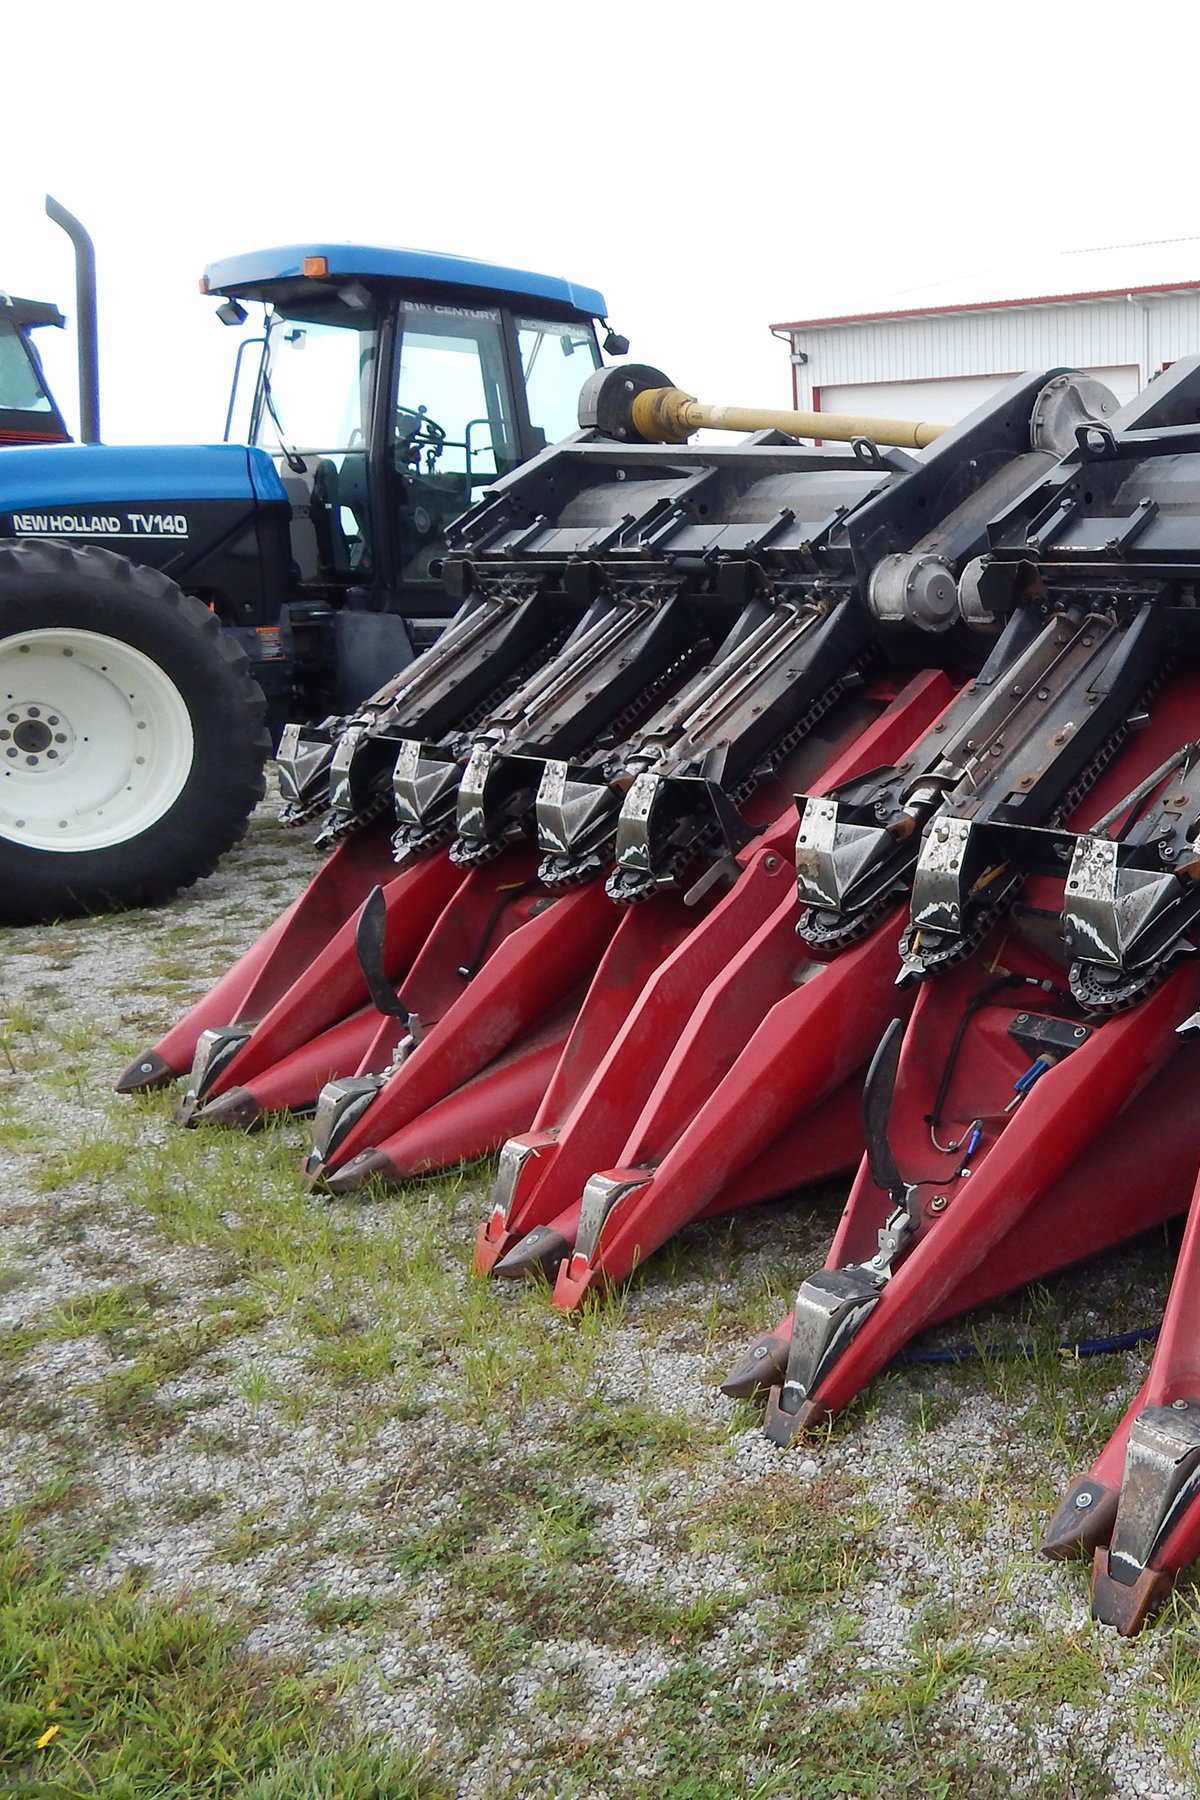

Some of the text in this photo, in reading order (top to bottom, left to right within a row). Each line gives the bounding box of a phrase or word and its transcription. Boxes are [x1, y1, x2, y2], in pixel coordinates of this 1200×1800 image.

[434, 305, 498, 321] CENTURY
[13, 513, 188, 534] NEW HOLLAND TV140
